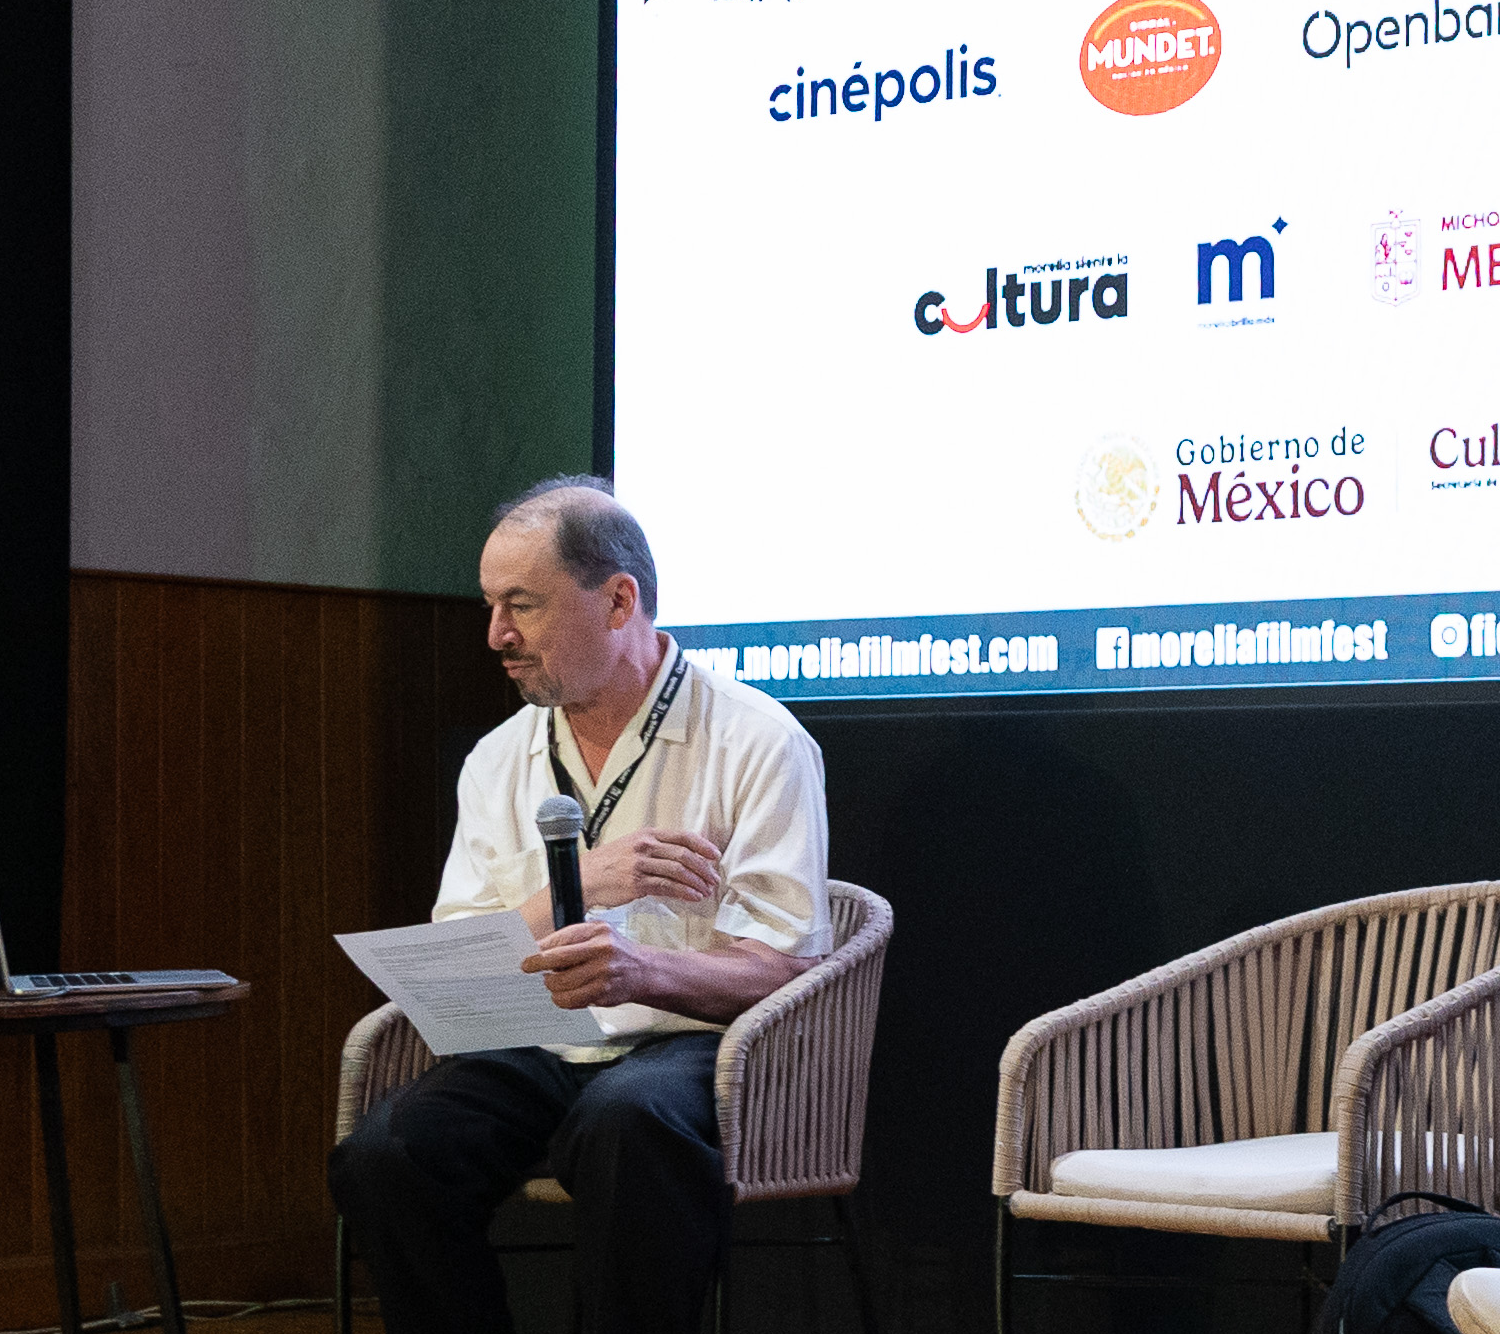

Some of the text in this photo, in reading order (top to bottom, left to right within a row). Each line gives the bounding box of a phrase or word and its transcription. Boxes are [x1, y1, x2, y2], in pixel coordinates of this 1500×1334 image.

[769, 44, 996, 122] cinépolis
[914, 268, 1128, 336] cultura
[1176, 435, 1319, 466] Gobierno
[1331, 427, 1364, 455] de
[1177, 464, 1364, 524] México
[684, 635, 1056, 681] ww.moreliafilmfest.com
